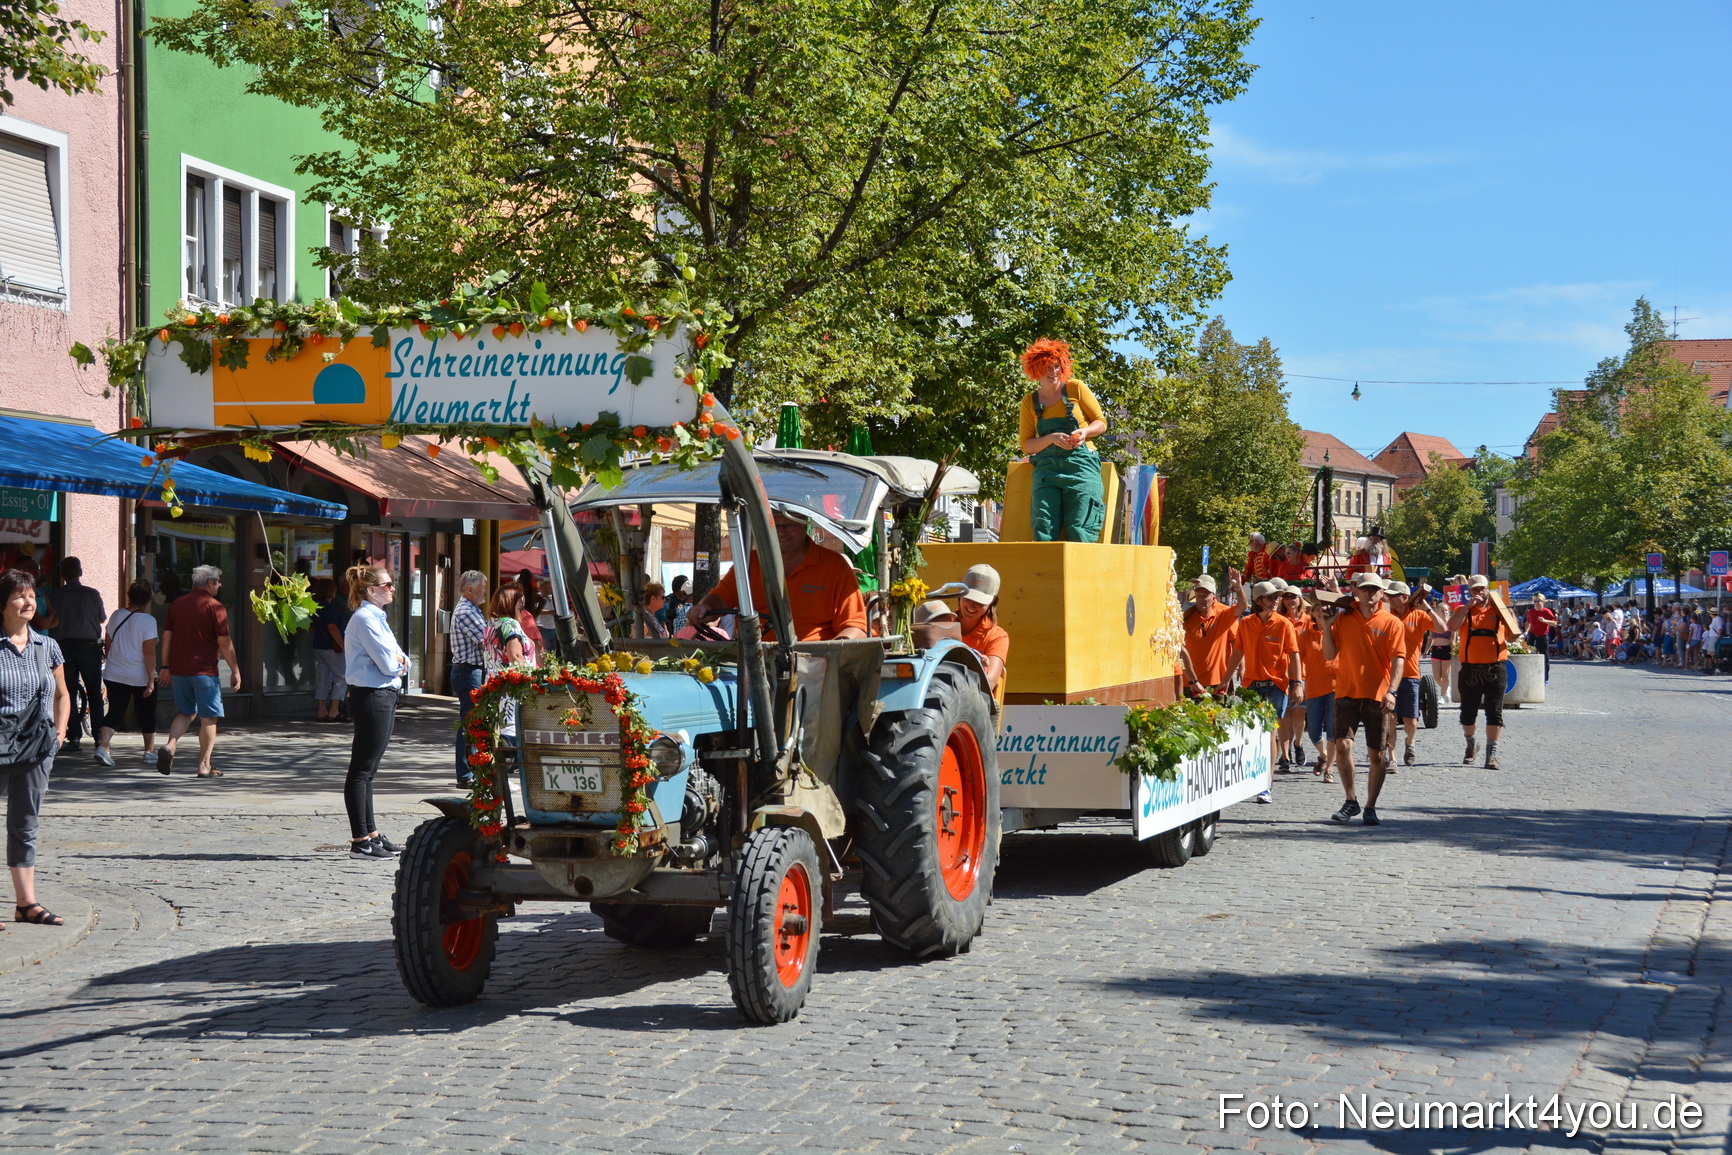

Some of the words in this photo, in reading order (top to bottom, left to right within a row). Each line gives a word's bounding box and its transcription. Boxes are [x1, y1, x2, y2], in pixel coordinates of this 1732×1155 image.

[384, 336, 626, 395] Schreinerinnung
[388, 379, 531, 423] Neumarkt
[1, 490, 28, 512] Essig
[549, 774, 560, 789] K
[573, 776, 597, 790] 136
[561, 760, 585, 774] NM
[1187, 744, 1244, 804] HANDWERK
